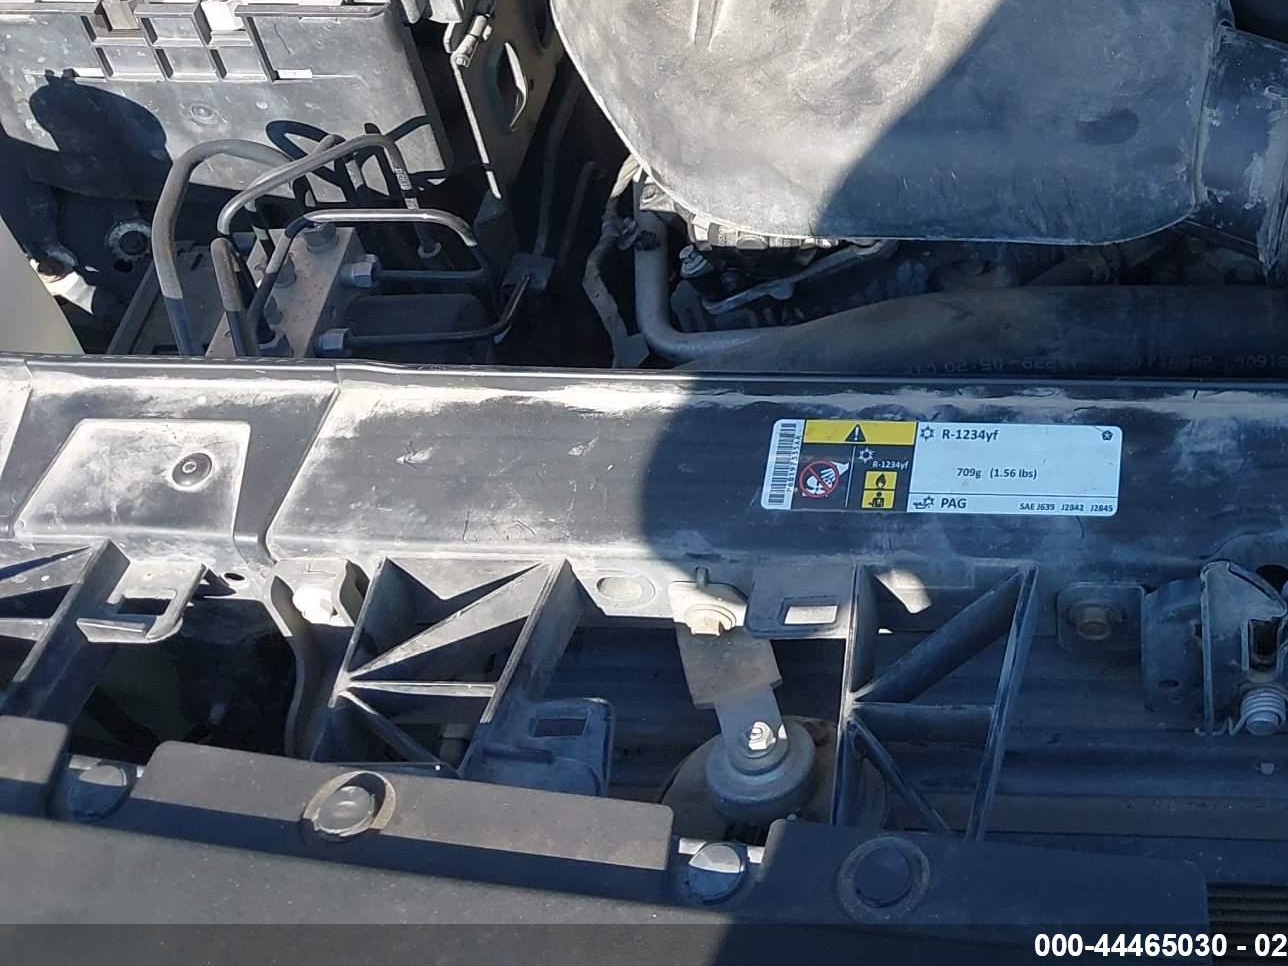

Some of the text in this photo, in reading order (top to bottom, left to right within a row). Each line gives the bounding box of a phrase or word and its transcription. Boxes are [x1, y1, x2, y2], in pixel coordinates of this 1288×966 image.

[941, 429, 999, 442] R-1234yf
[872, 459, 909, 470] R-1234yf
[957, 467, 1038, 480] 709g (1.56 lbs)
[940, 497, 966, 509] PAG
[1020, 502, 1036, 511] SAE
[1037, 503, 1055, 511] J639
